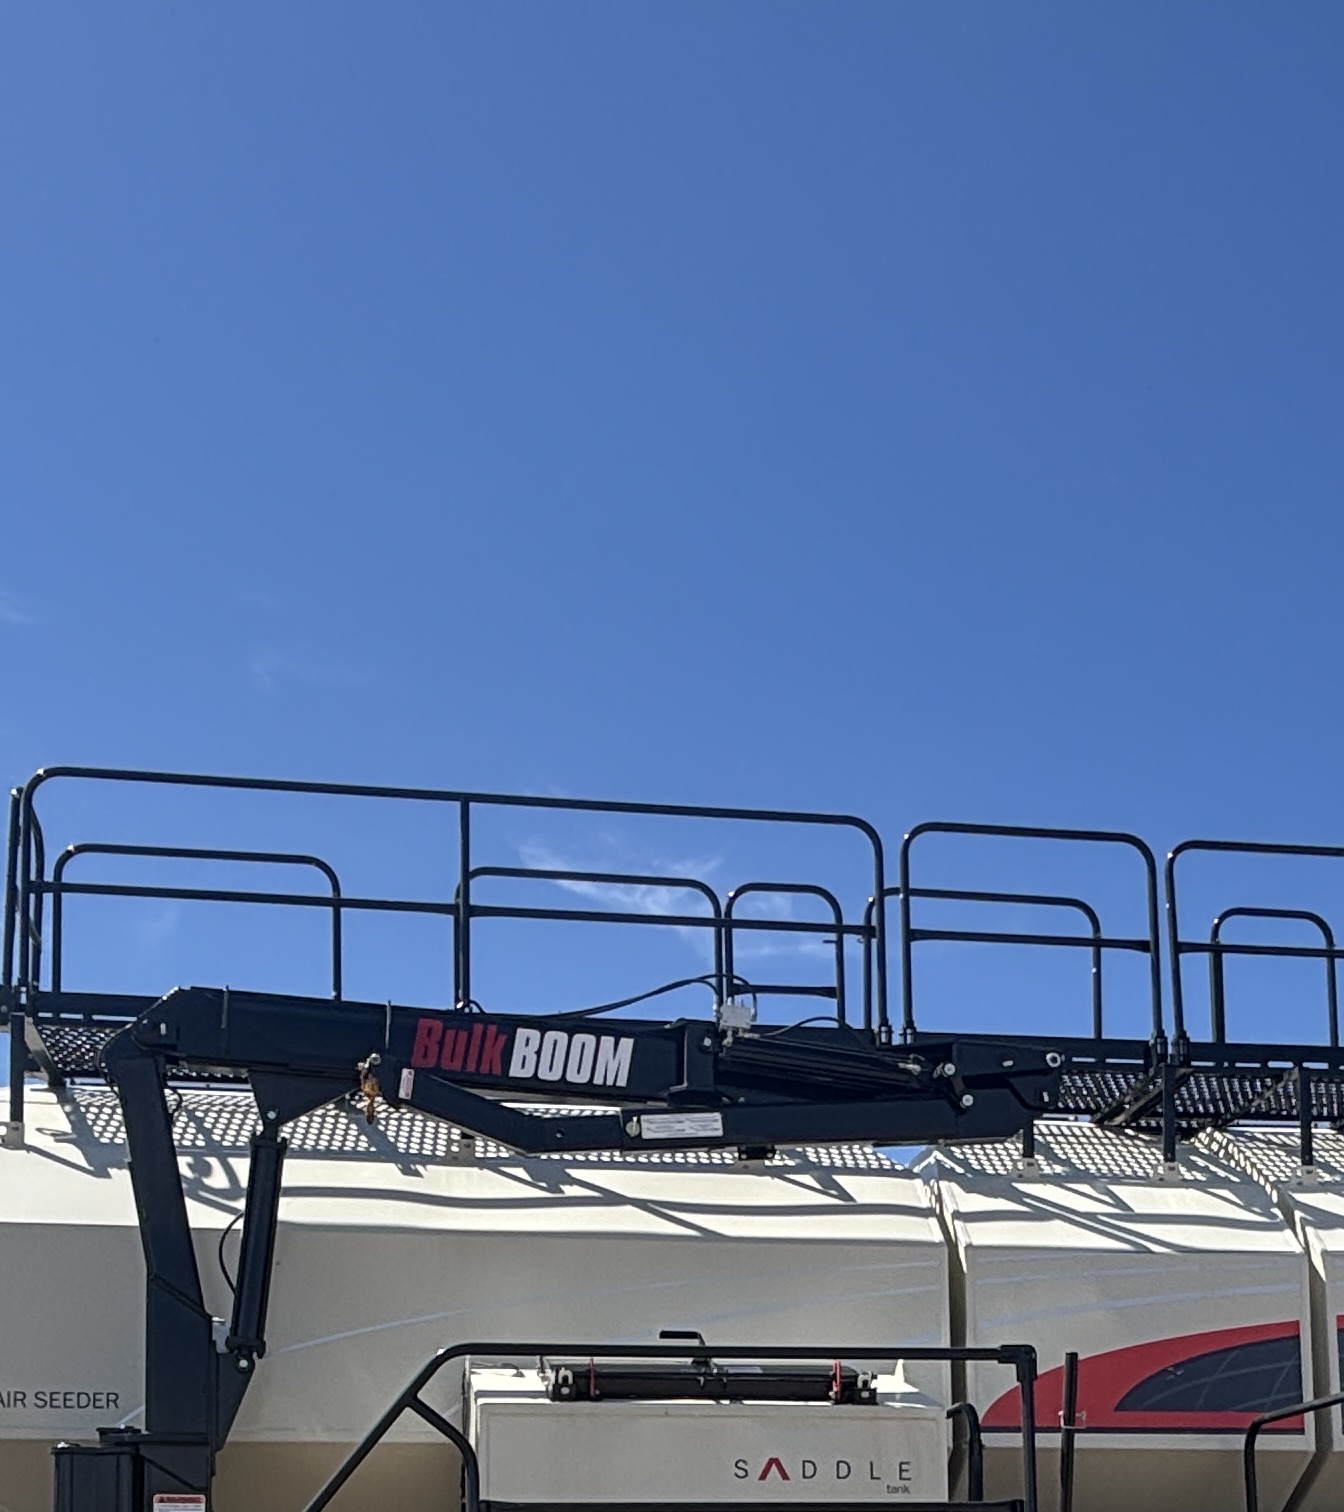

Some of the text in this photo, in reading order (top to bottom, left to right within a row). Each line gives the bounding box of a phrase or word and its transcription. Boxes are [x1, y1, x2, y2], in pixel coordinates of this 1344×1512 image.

[34, 1391, 120, 1409] SEEDER
[734, 1457, 912, 1481] SADDLE
[886, 1484, 910, 1494] tank
